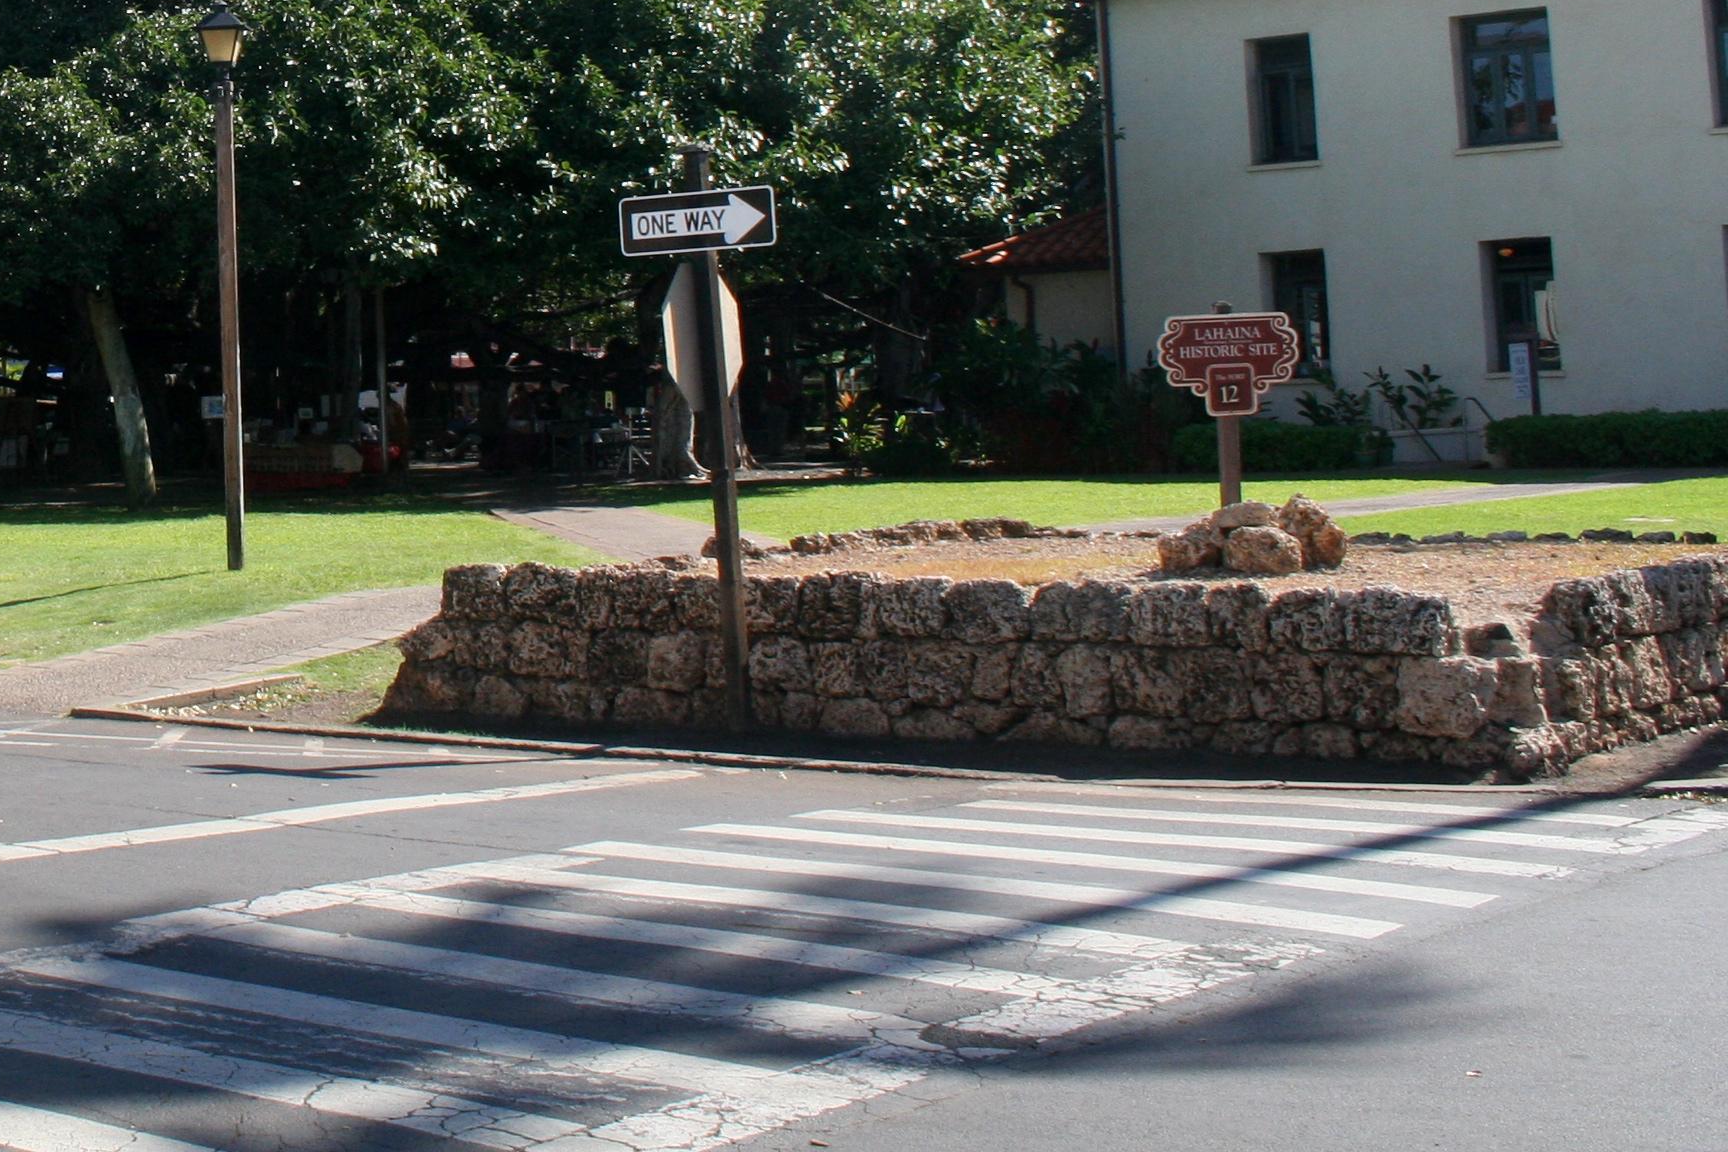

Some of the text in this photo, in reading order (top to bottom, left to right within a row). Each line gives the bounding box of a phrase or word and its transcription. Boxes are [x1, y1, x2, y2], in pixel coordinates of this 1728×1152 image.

[637, 209, 726, 236] ONE WAY
[1194, 326, 1262, 341] LAHAINA
[1179, 343, 1278, 359] HISTORIC SITE
[1220, 385, 1240, 403] 12
